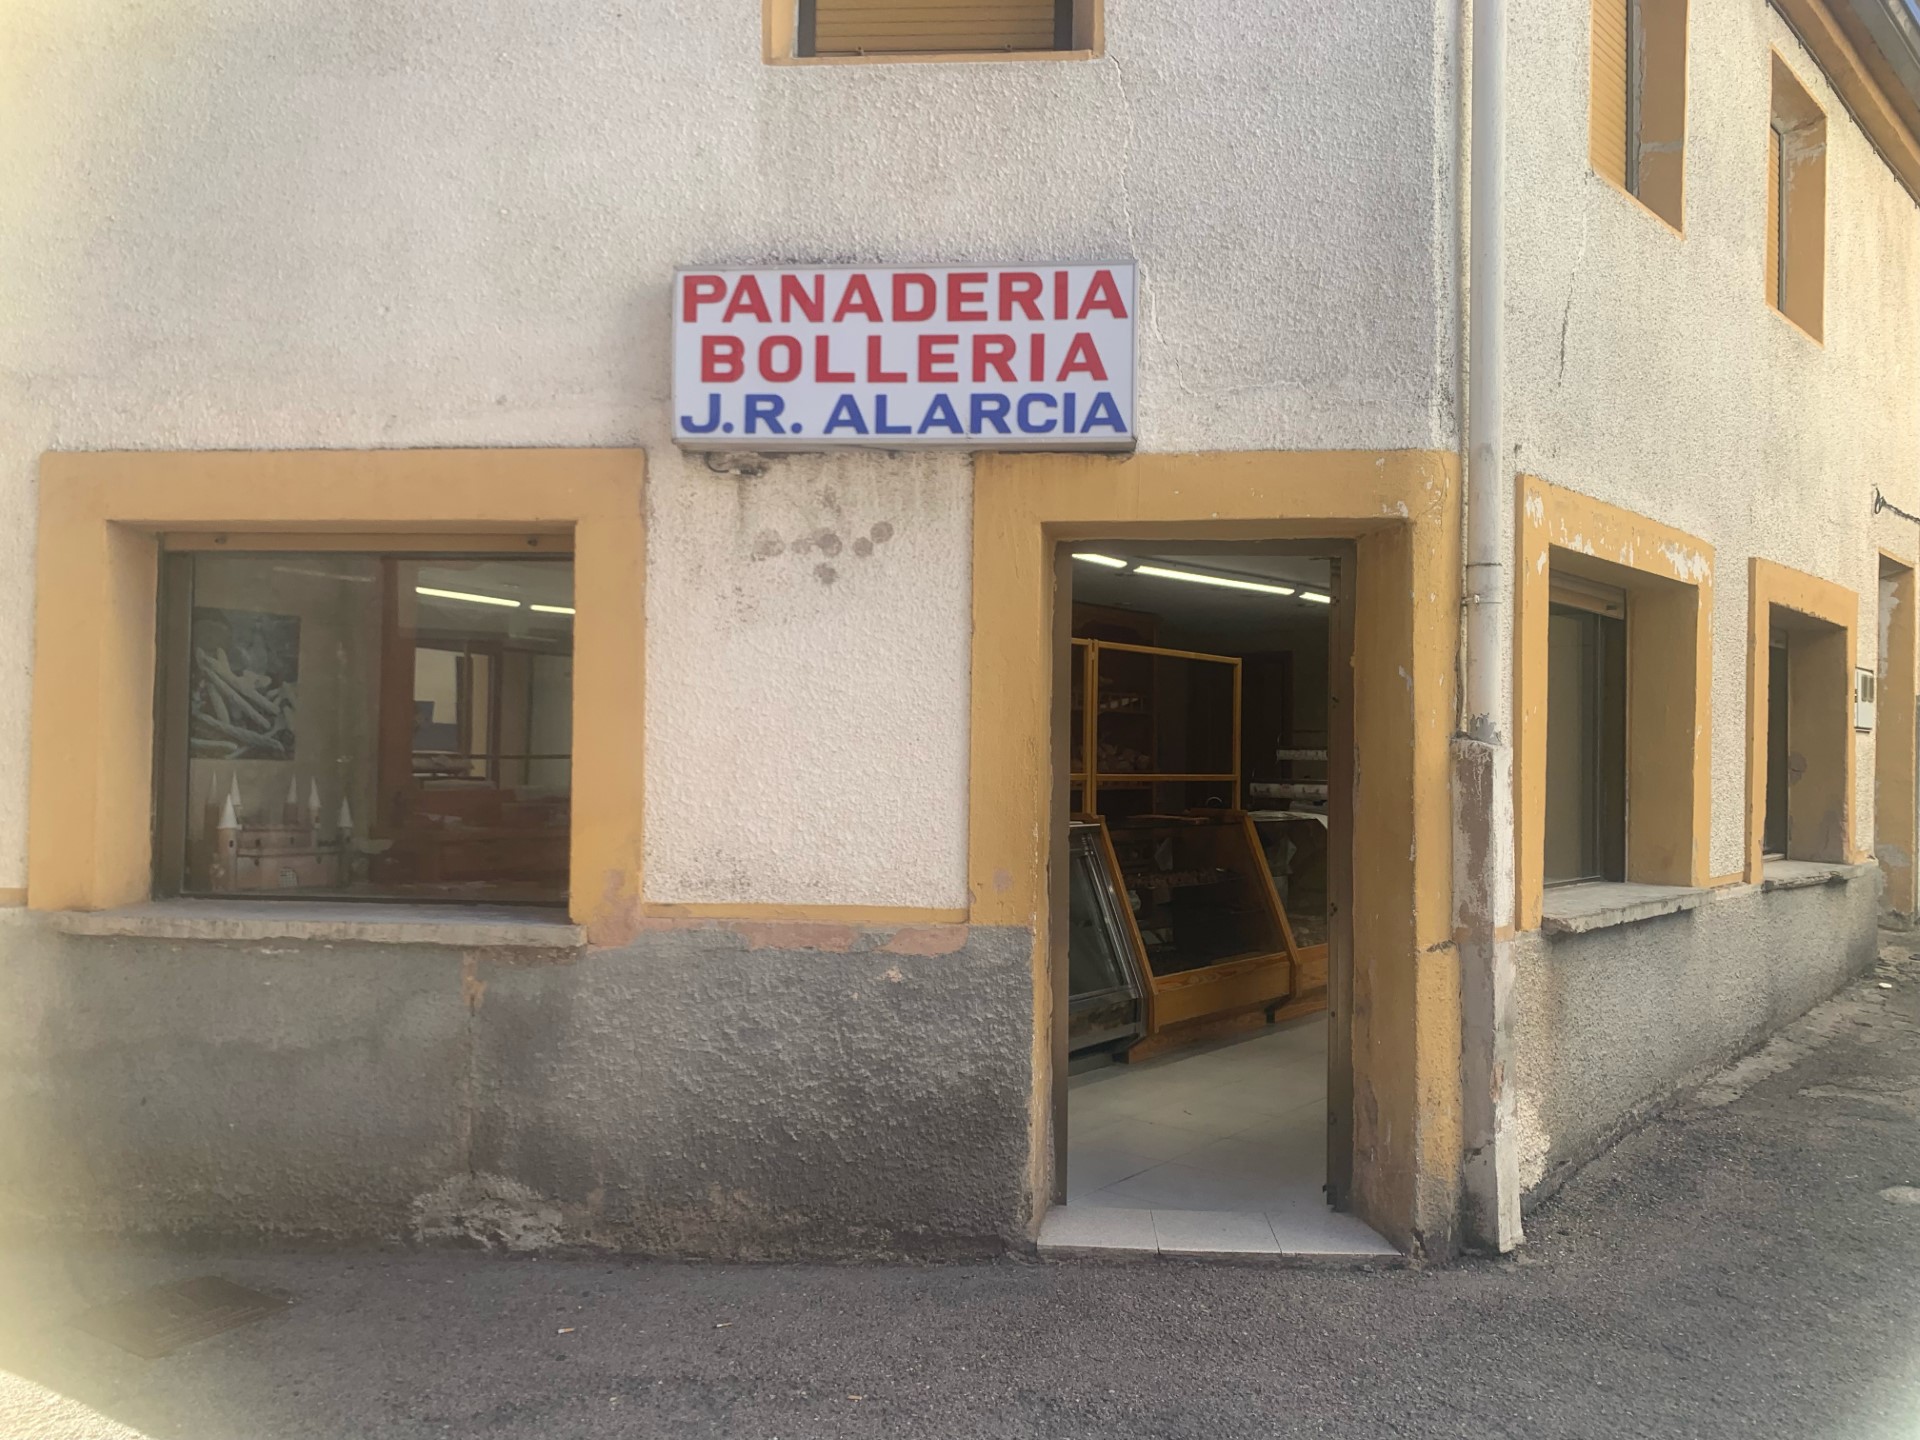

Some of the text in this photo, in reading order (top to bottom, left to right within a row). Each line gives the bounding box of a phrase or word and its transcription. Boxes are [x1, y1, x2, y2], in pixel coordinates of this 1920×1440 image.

[682, 269, 1128, 323] PANADERIA
[701, 332, 1109, 383] BOLLERIA
[680, 392, 1128, 434] J.R. ALARCIA
